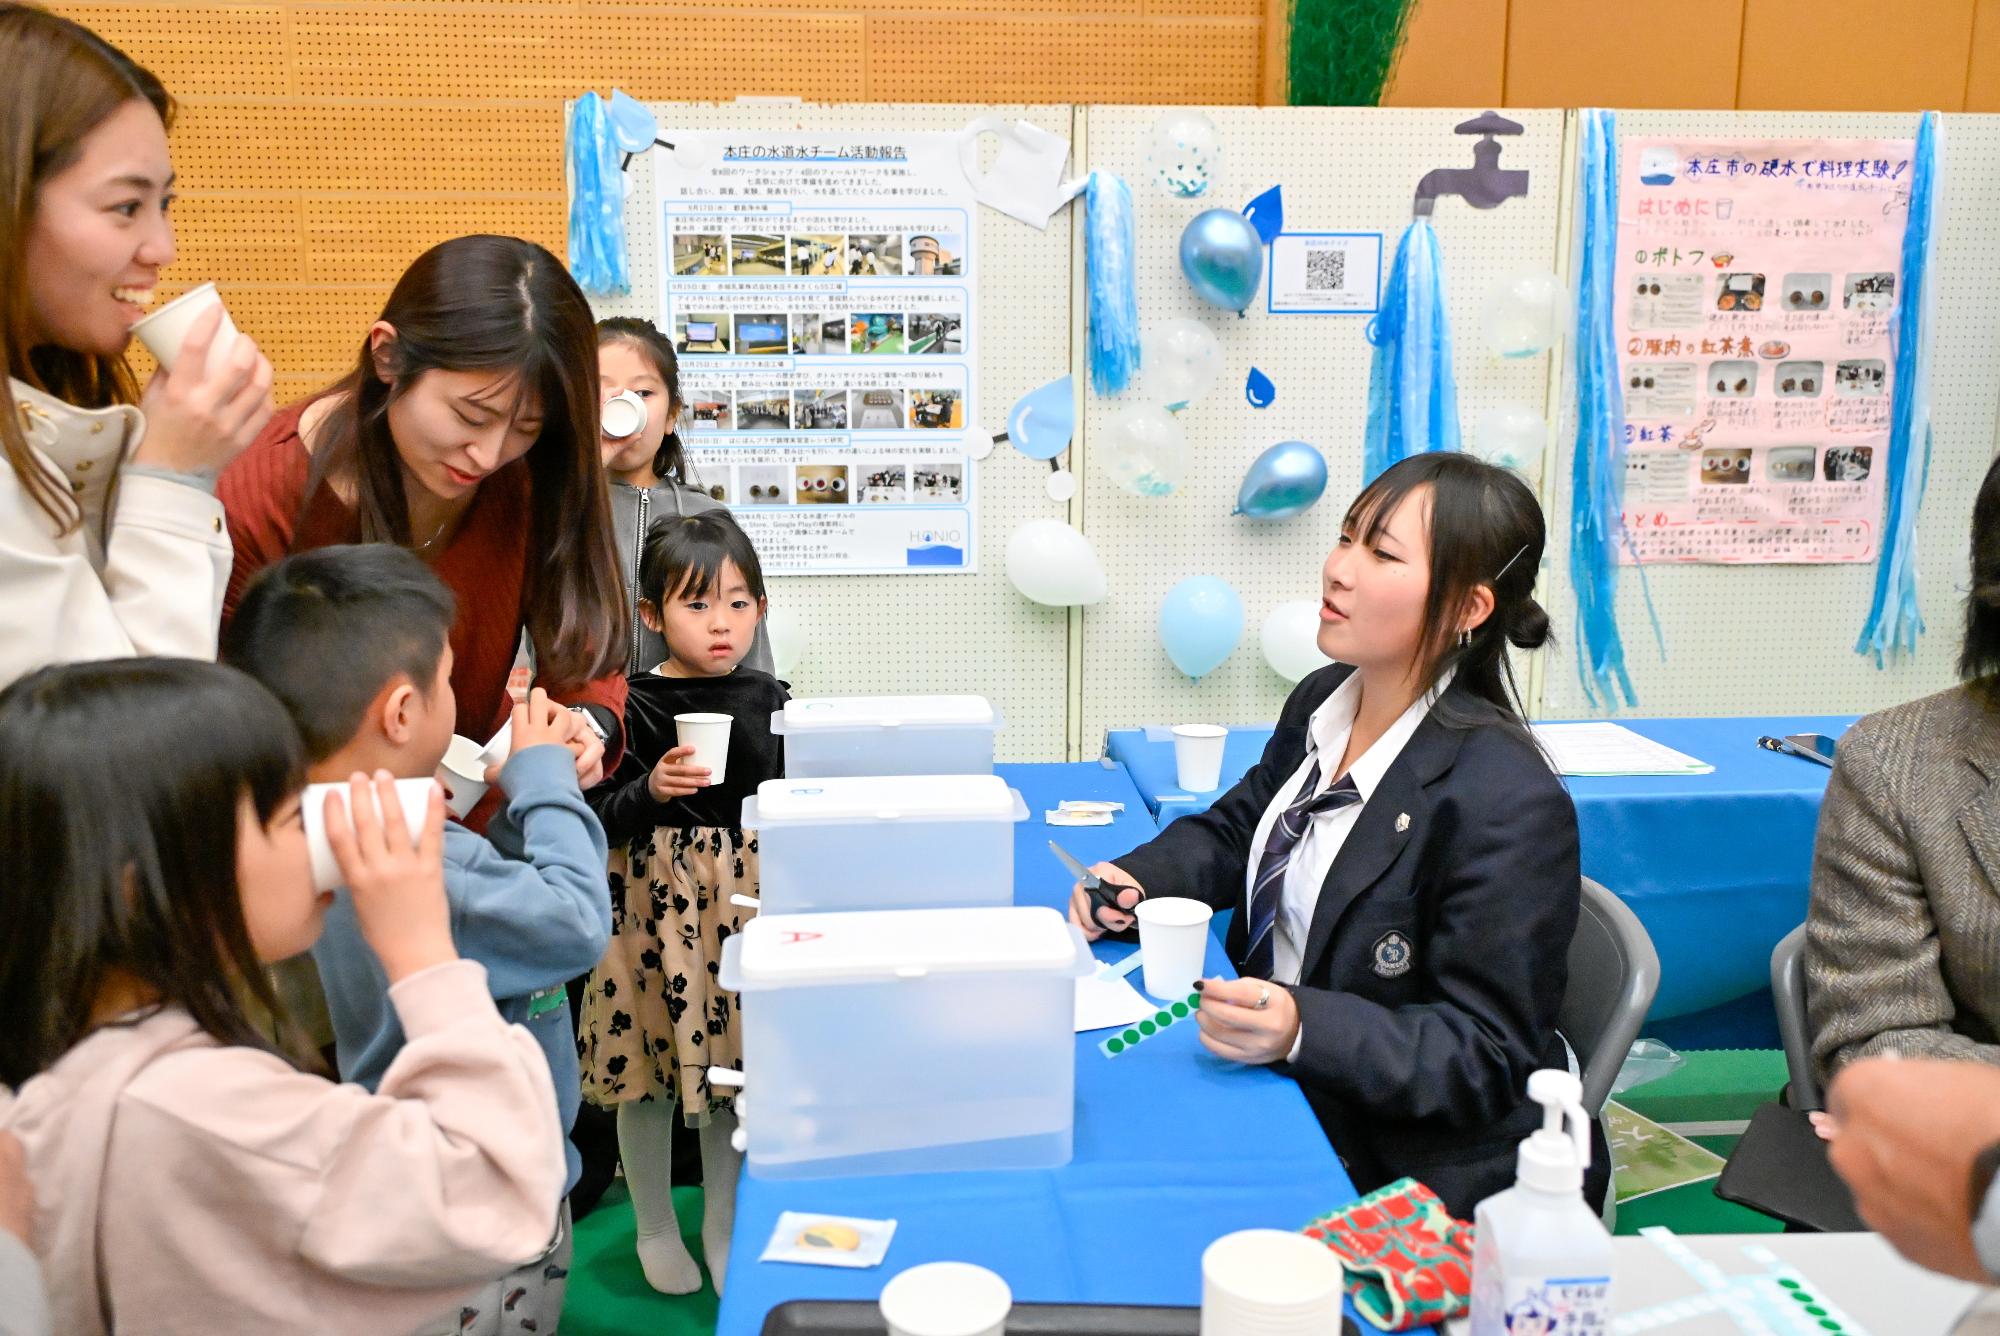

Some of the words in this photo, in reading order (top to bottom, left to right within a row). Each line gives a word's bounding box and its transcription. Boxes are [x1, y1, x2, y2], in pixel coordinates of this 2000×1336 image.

[723, 145, 907, 159] 本庄の水道水チーム活動報告
[1637, 198, 1711, 217] はじめに
[780, 929, 825, 945] A
